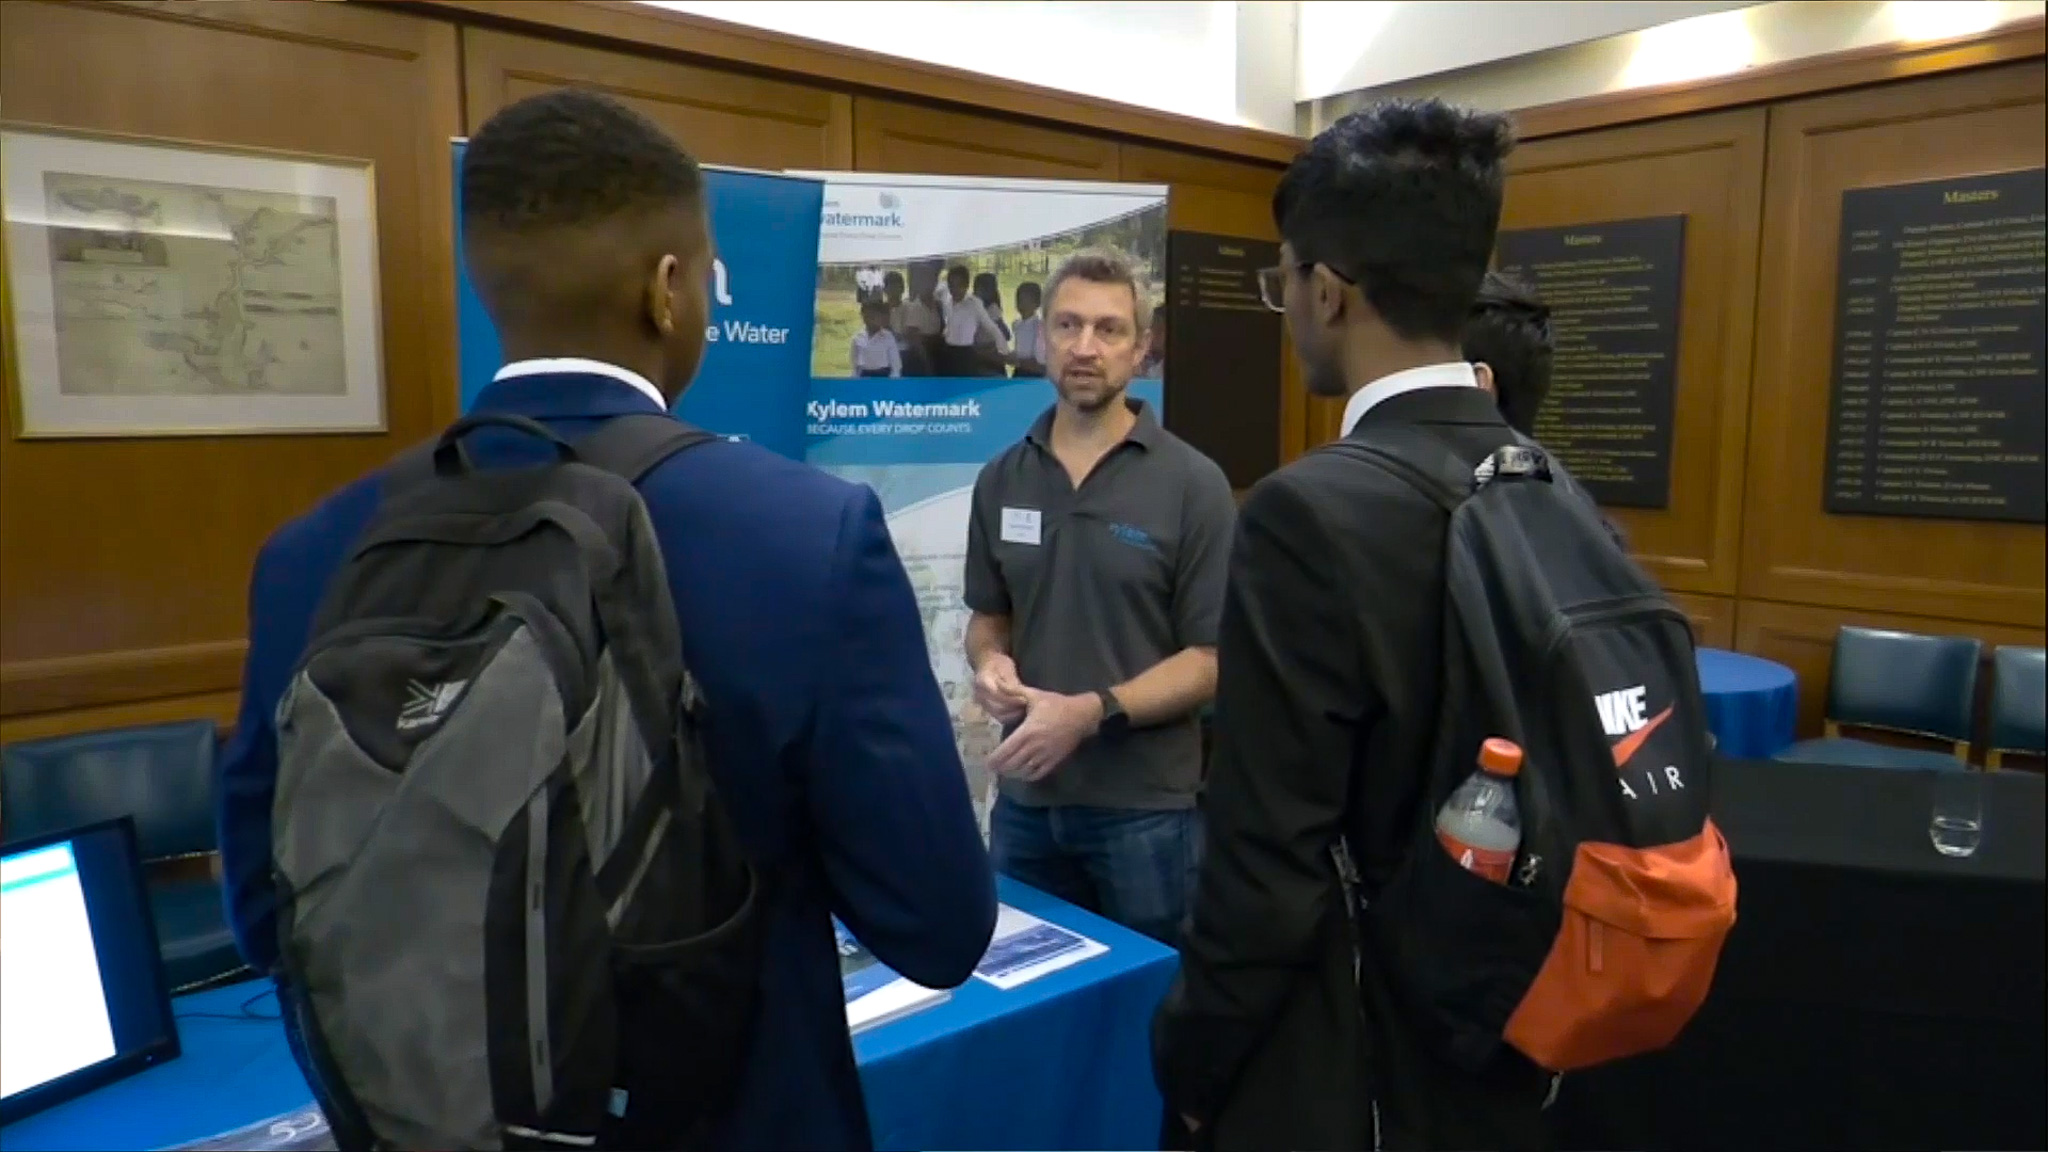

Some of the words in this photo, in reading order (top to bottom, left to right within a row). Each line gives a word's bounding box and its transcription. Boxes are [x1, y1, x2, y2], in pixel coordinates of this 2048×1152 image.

[723, 320, 790, 344] Water
[872, 398, 981, 418] Watermark
[858, 423, 893, 434] EVERY
[894, 423, 926, 434] DROP
[927, 422, 972, 434] COUNTS
